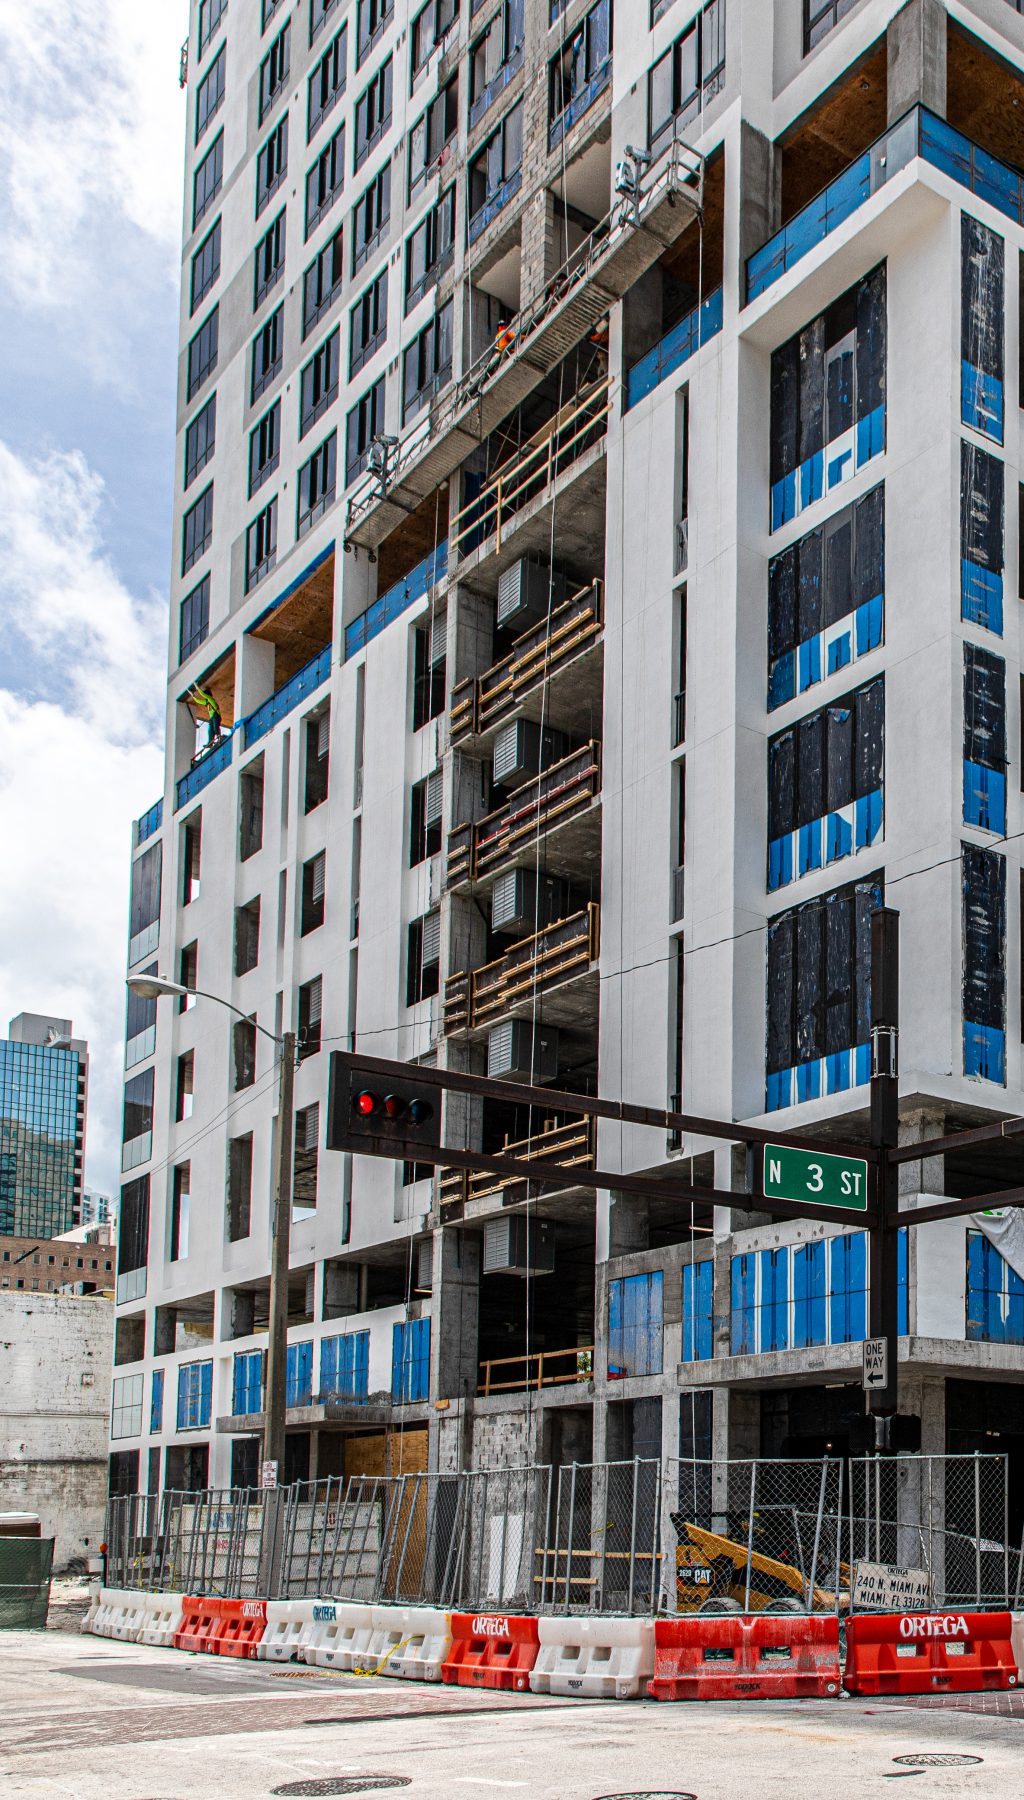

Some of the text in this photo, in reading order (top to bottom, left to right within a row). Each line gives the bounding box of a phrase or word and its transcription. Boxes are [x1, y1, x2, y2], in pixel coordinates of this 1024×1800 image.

[769, 1159, 862, 1196] N 3 ST
[866, 1342, 883, 1356] ONE
[865, 1356, 884, 1370] WAY
[694, 1569, 712, 1584] CAT
[857, 1575, 875, 1589] 240
[889, 1580, 914, 1595] MIAMI
[242, 1602, 264, 1617] ORTEGA
[891, 1595, 902, 1608] FL
[903, 1596, 926, 1609] 33128
[471, 1616, 510, 1637] ORTEGA
[899, 1615, 969, 1638] ORTEGA
